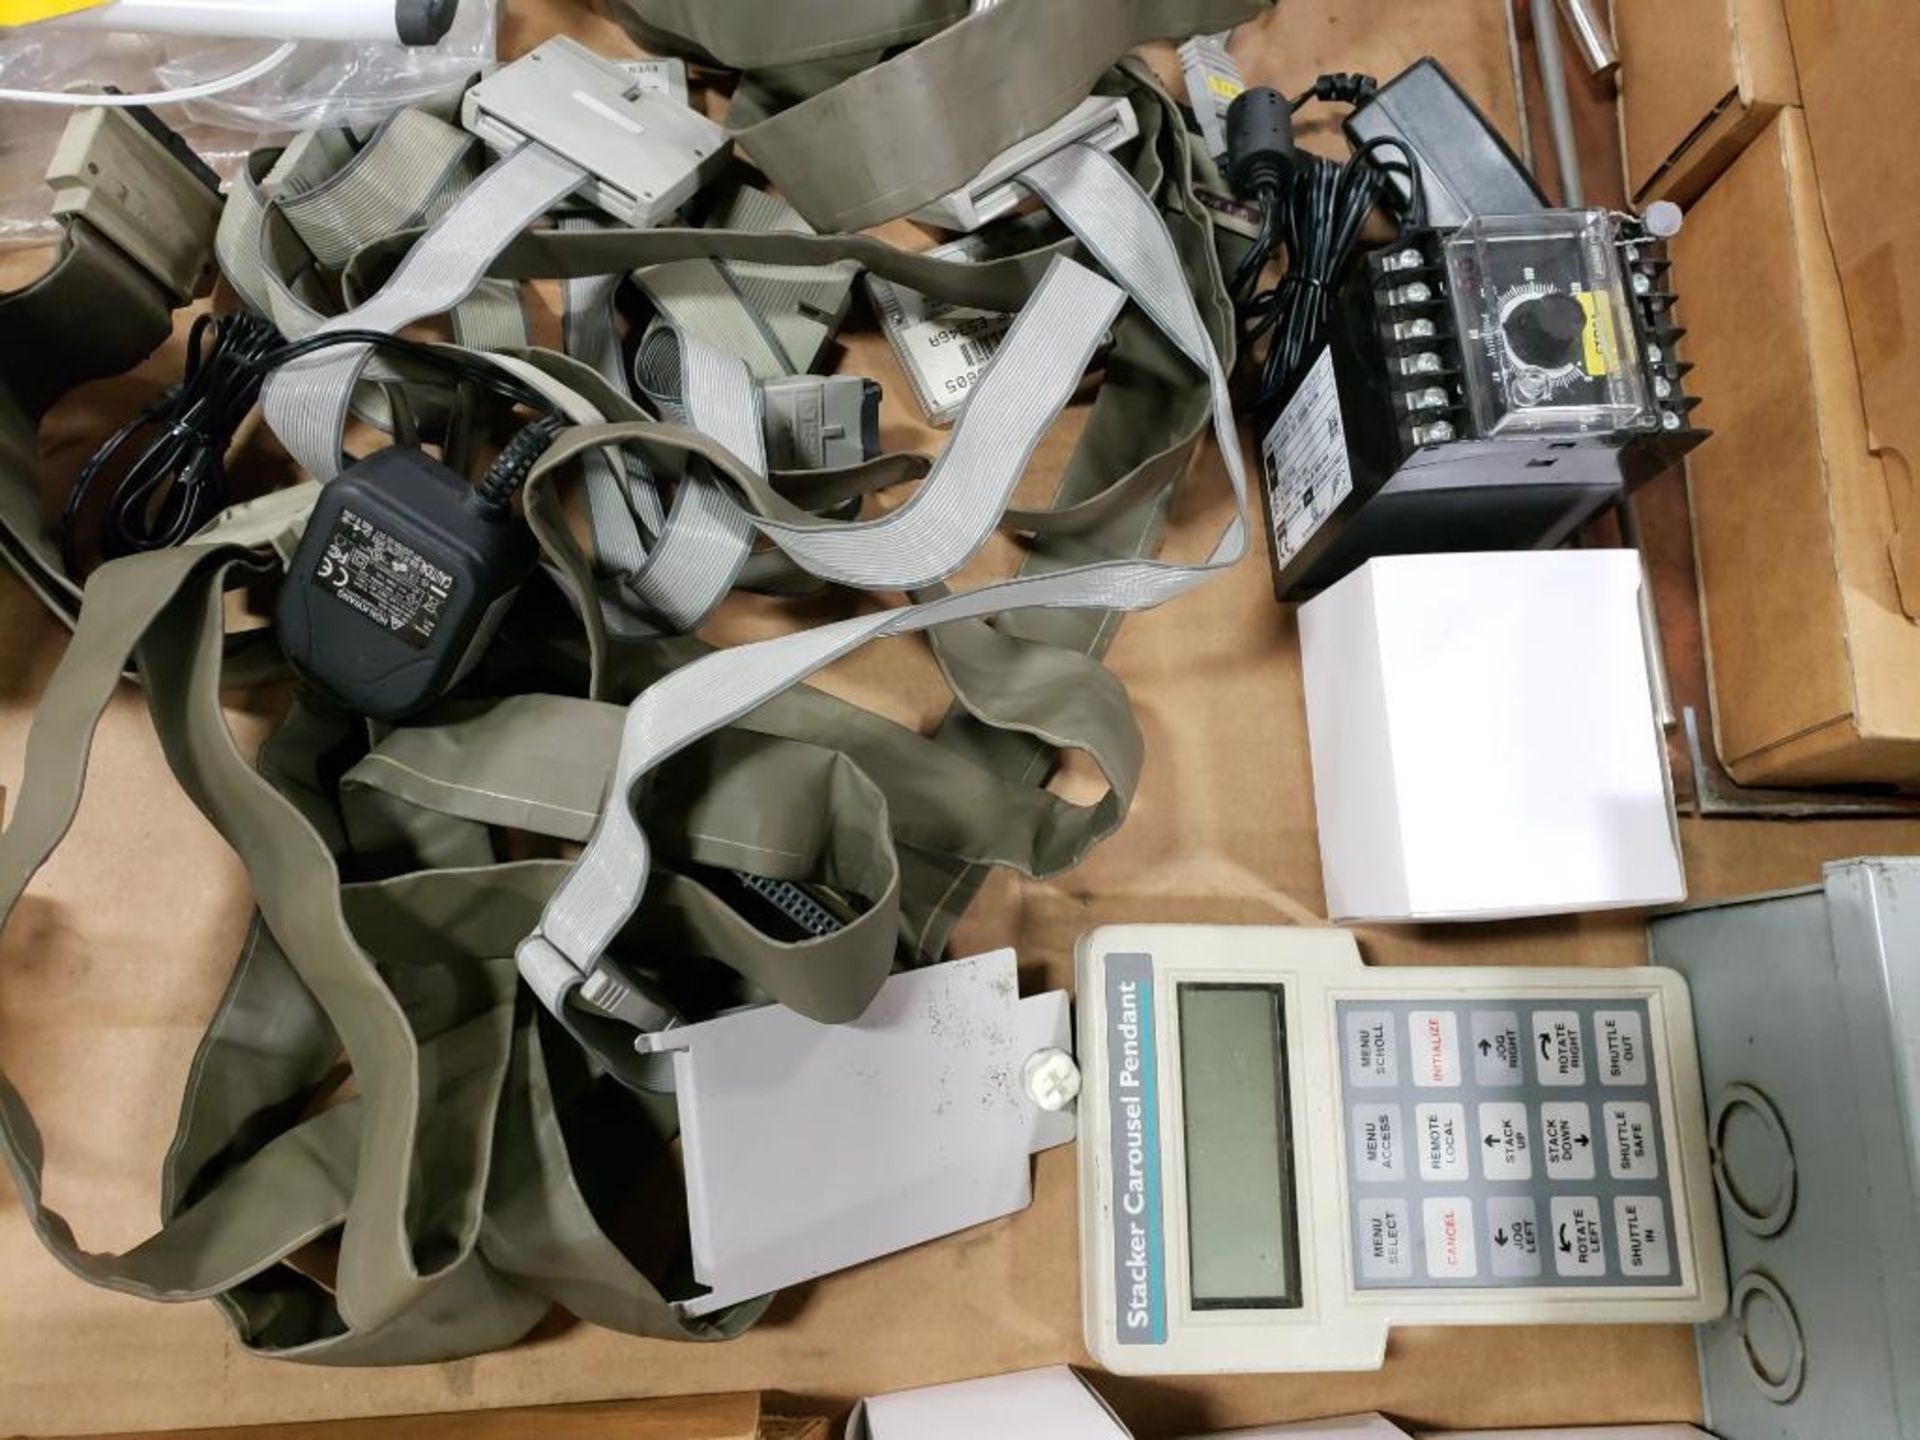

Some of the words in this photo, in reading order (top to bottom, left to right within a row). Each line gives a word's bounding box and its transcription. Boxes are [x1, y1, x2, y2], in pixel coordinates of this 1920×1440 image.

[1117, 980, 1141, 1087] Pendant
[1359, 1029, 1373, 1068] MENU
[1427, 1016, 1443, 1082] INITIALIZE
[1495, 1034, 1508, 1062] JOG
[1506, 1028, 1520, 1070] RIGHT
[1554, 1022, 1570, 1075] ROTATE
[1566, 1028, 1581, 1070] RIGHT
[1604, 1018, 1622, 1078] SHUTTLE
[1620, 1034, 1634, 1063] OUT
[1119, 1096, 1145, 1215] Carousel
[1365, 1121, 1378, 1162] MENU
[1380, 1113, 1393, 1170] ACCESS
[1428, 1113, 1442, 1170] REMOTE
[1444, 1117, 1457, 1164] LOCAL
[1501, 1118, 1515, 1164] STACK
[1515, 1131, 1527, 1151] UP
[1545, 1118, 1560, 1164] STACK
[1560, 1119, 1573, 1161] DOWN
[1614, 1110, 1632, 1171] SHUTTLE
[1631, 1122, 1645, 1159] SAFE
[1371, 1217, 1384, 1259] MENU
[1385, 1211, 1401, 1266] SELECT
[1445, 1209, 1460, 1267] CANCEL
[1511, 1221, 1524, 1250] JOG
[1523, 1220, 1537, 1254] LEFT
[1573, 1208, 1589, 1264] ROTATE
[1586, 1219, 1601, 1254] LEFT
[1625, 1205, 1643, 1268] SHUTTLE
[1643, 1229, 1656, 1243] IN
[1125, 1223, 1149, 1329] Stacker
